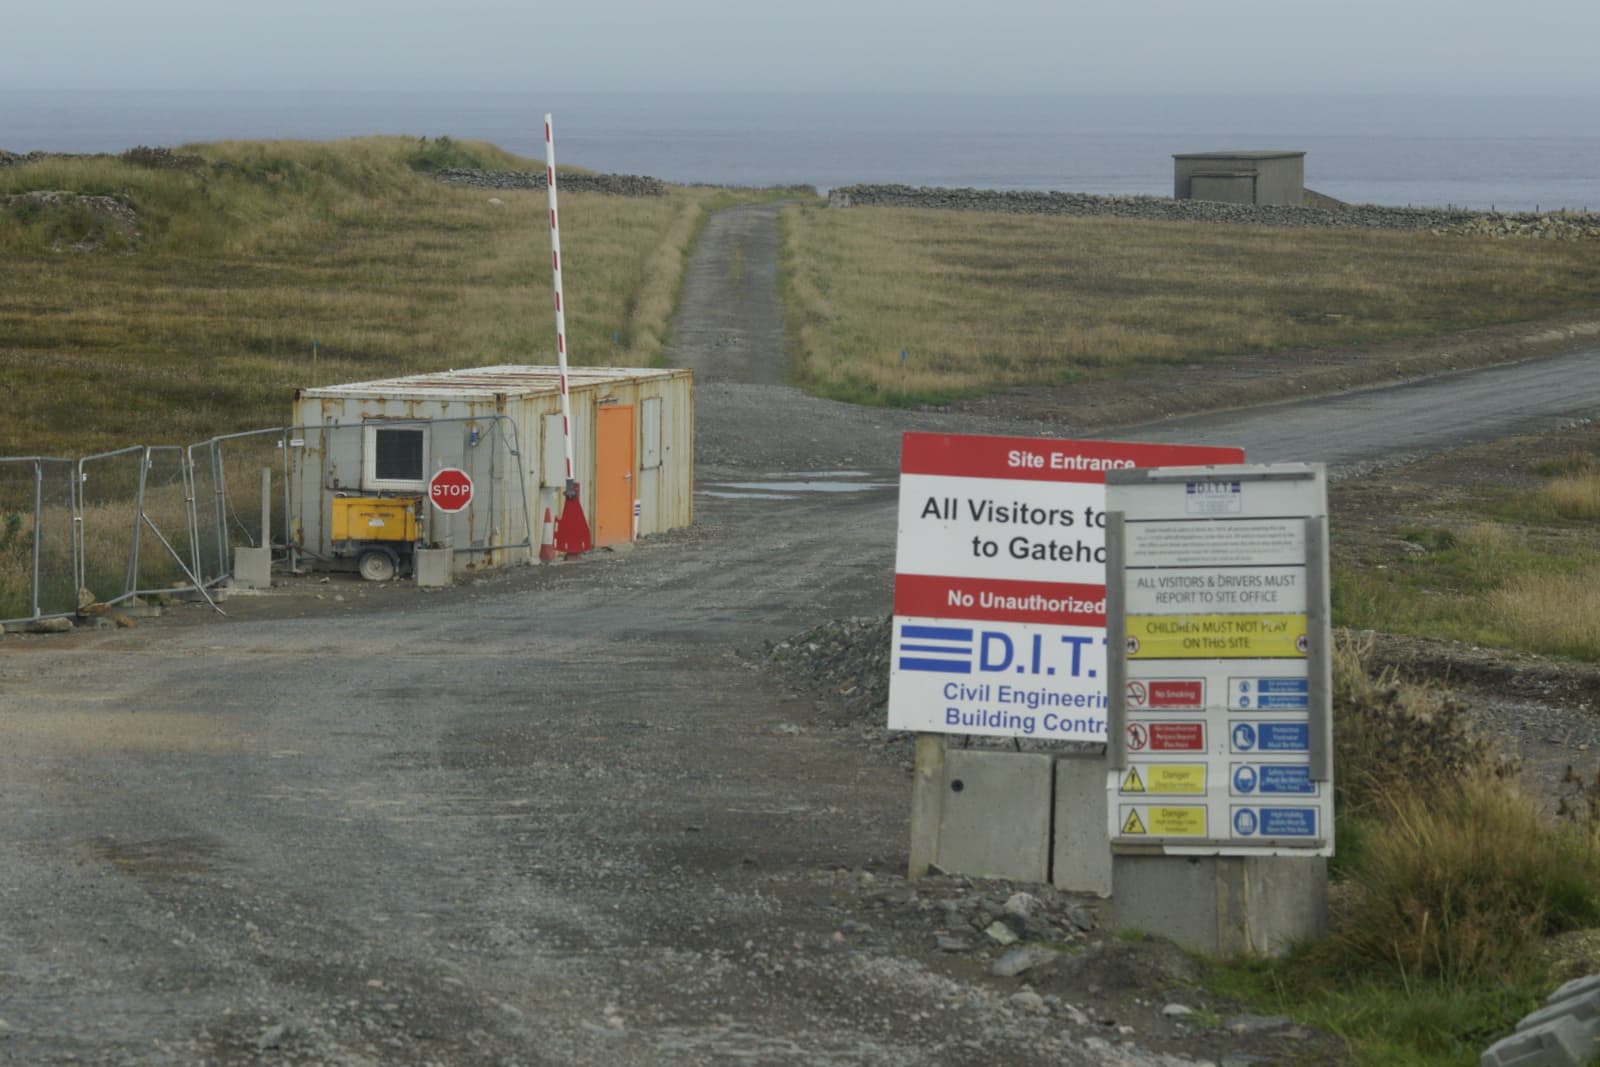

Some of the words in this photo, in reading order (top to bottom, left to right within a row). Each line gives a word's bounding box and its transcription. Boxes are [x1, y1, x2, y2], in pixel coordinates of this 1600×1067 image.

[1007, 451, 1044, 468] Site
[1050, 453, 1135, 471] Entrance
[432, 484, 470, 497] STOP
[920, 497, 958, 520] All
[968, 499, 1074, 526] Visitors
[972, 536, 999, 557] to
[1137, 577, 1156, 588] ALL
[1158, 576, 1206, 588] VISITORS
[1208, 577, 1215, 587] &
[1217, 575, 1263, 588] DRIVERS
[1264, 574, 1296, 587] MUST
[947, 590, 974, 607] No
[980, 592, 1106, 614] Unauthorized
[1156, 592, 1196, 604] REPORT
[1199, 591, 1214, 603] TO
[1216, 591, 1237, 603] SITE
[1239, 591, 1277, 602] OFFICE
[1146, 621, 1199, 633] CHILDREN
[1202, 621, 1233, 632] MUST
[1235, 621, 1257, 632] NOT
[1260, 621, 1287, 632] PLAY
[1183, 638, 1201, 649] ON
[1203, 638, 1227, 649] THIS
[1230, 637, 1251, 649] SITE
[979, 631, 1107, 678] D.I.T.
[943, 683, 990, 702] Civil
[945, 708, 1036, 734] Building
[1043, 713, 1107, 734] Contr
